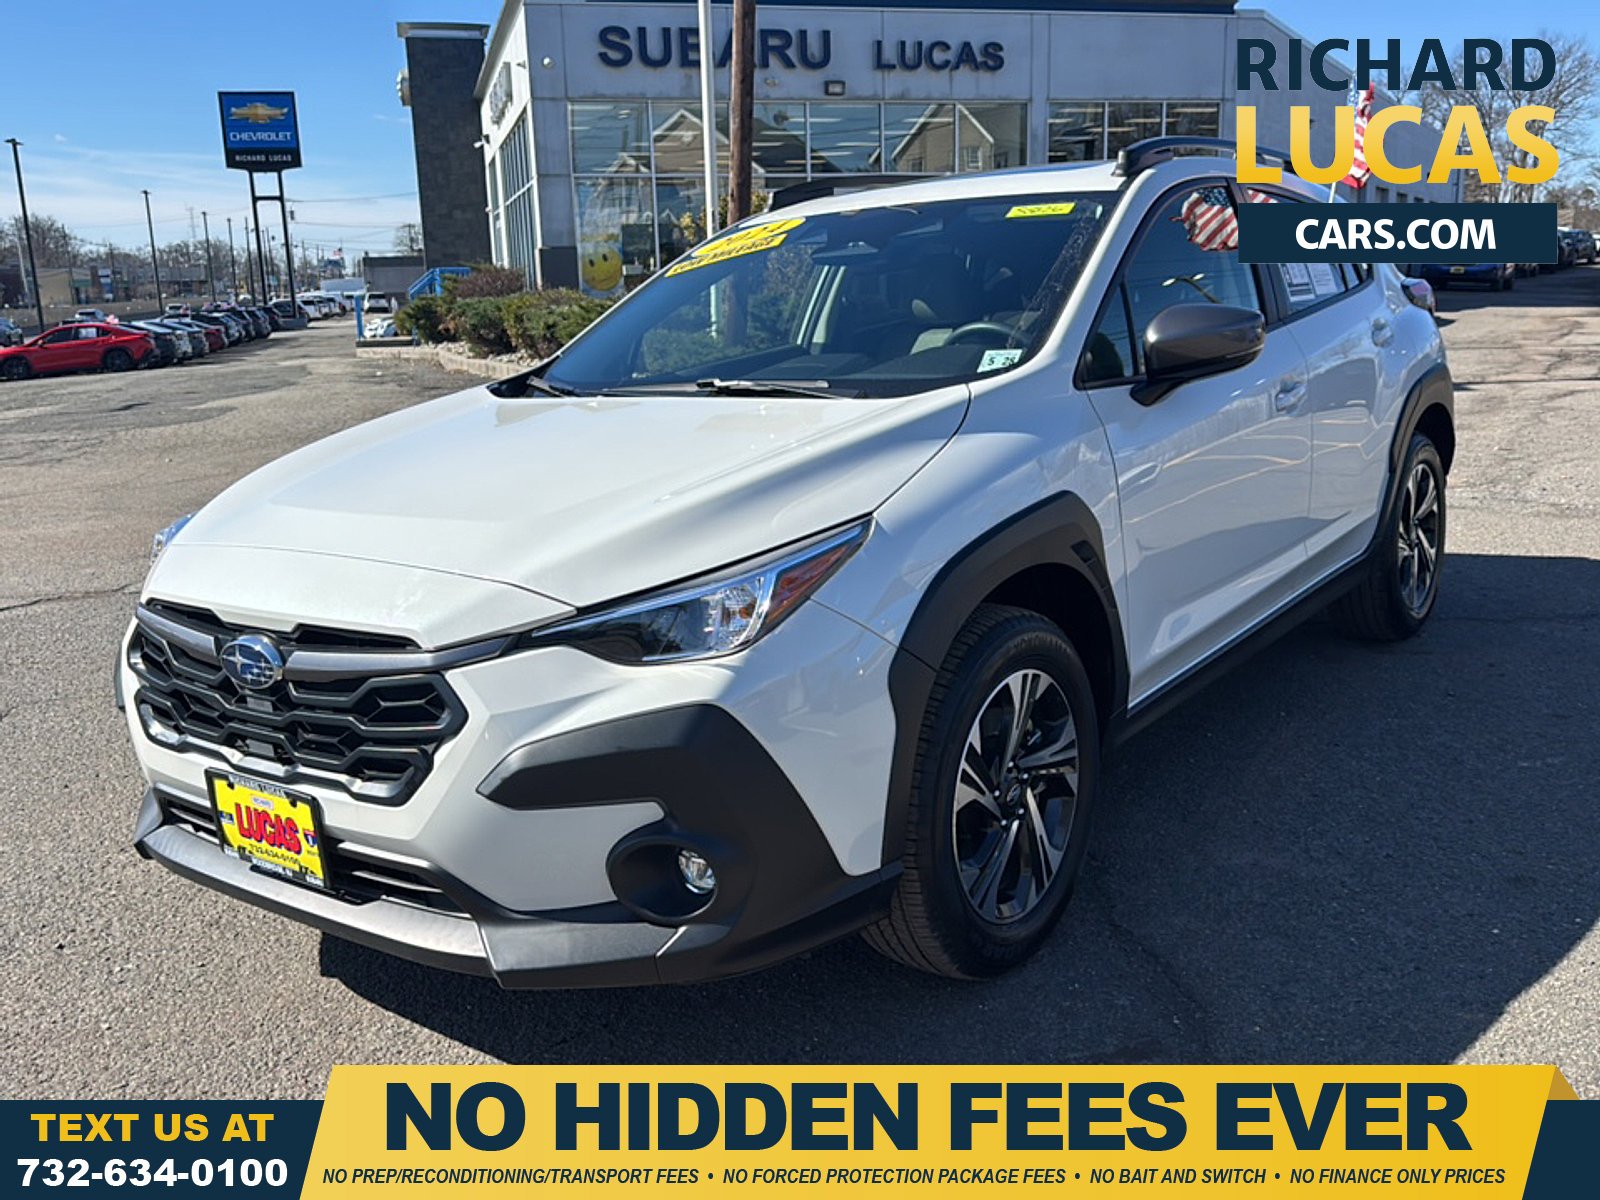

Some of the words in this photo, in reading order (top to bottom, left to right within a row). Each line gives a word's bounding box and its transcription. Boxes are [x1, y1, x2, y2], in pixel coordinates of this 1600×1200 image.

[873, 39, 1006, 72] LUCAS
[230, 131, 292, 142] CHEVROLET
[235, 801, 303, 856] LUCAS
